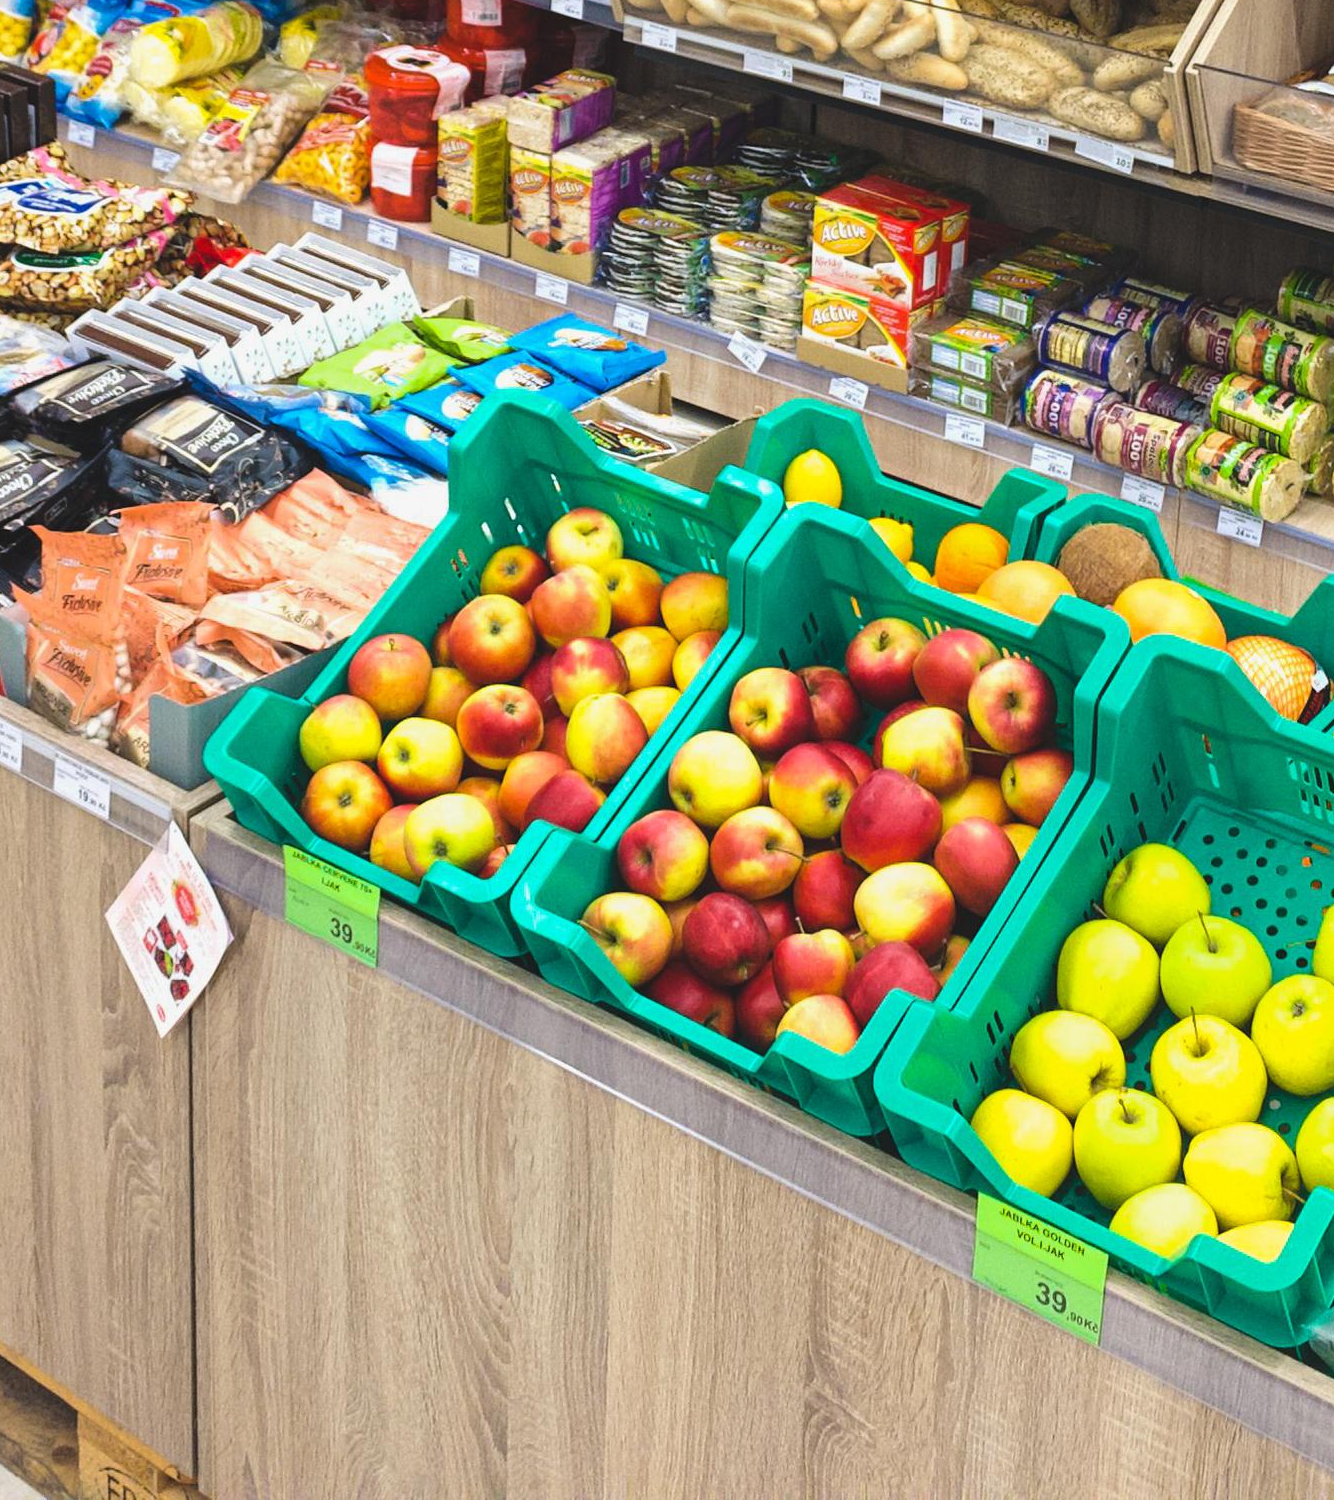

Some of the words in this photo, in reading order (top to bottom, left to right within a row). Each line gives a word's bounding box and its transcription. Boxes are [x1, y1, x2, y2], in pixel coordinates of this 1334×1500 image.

[821, 218, 867, 242] Active
[810, 300, 859, 325] Active
[211, 430, 241, 453] Choco
[330, 917, 353, 944] 39
[999, 1206, 1040, 1234] JABLKA
[1041, 1225, 1085, 1257] GOLDEN
[1035, 1281, 1067, 1315] 39
